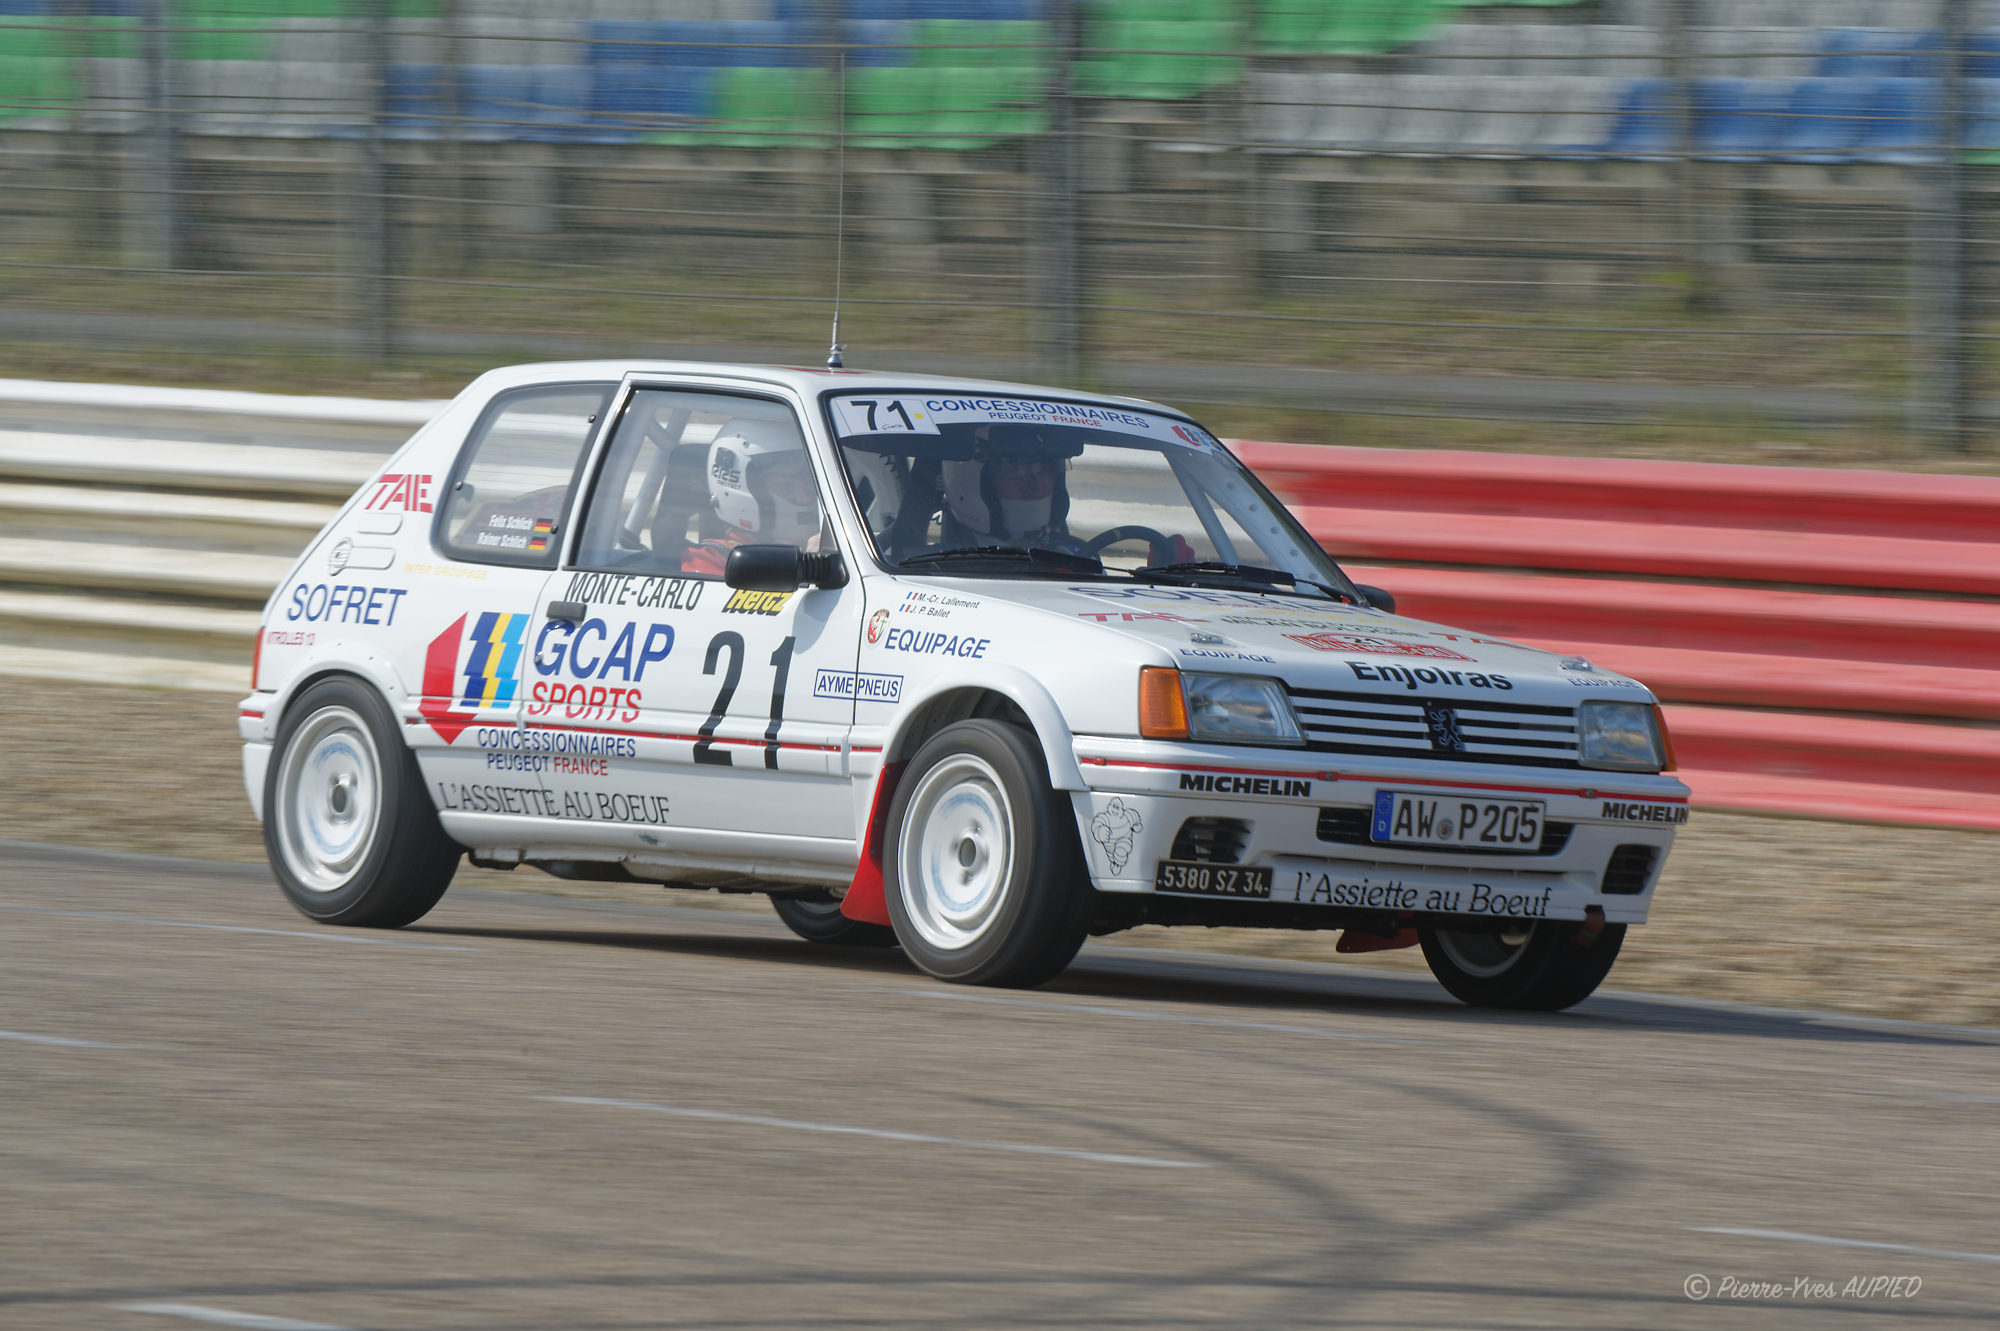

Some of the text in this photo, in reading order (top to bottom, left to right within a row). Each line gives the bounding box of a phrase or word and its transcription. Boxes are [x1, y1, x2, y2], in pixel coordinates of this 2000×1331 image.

[850, 400, 915, 431] 71
[926, 400, 1150, 429] CONCESSIONNAIRES
[989, 411, 1102, 427] PEUGEOT FRANCE
[287, 583, 408, 626] SOFRET
[564, 572, 704, 611] MONTE-CARLO
[722, 589, 793, 616] Hertz
[941, 596, 980, 609] Lallement
[927, 608, 950, 618] Ballet
[535, 618, 675, 683] GCAP
[884, 627, 991, 659] EQUIPAGE
[1180, 648, 1277, 664] EQUIPAGE
[817, 675, 899, 698] AYME PNEUS
[1344, 660, 1513, 690] Enjolras
[1568, 678, 1642, 690] EQUIPAGE
[528, 681, 642, 723] SPORTS
[693, 631, 796, 770] 21
[478, 728, 636, 758] CONCESSIONNAIRES
[487, 753, 608, 776] PEUGEOT FRANCE
[1179, 773, 1311, 798] MICHELIN
[438, 782, 670, 824] L'ASSIETTE AU BOEUF
[1601, 801, 1689, 825] MICHELIN
[1394, 800, 1438, 838] AW
[1164, 865, 1264, 895] 5380 SZ 34
[1294, 871, 1552, 917] l'Assiette au Boeuf
